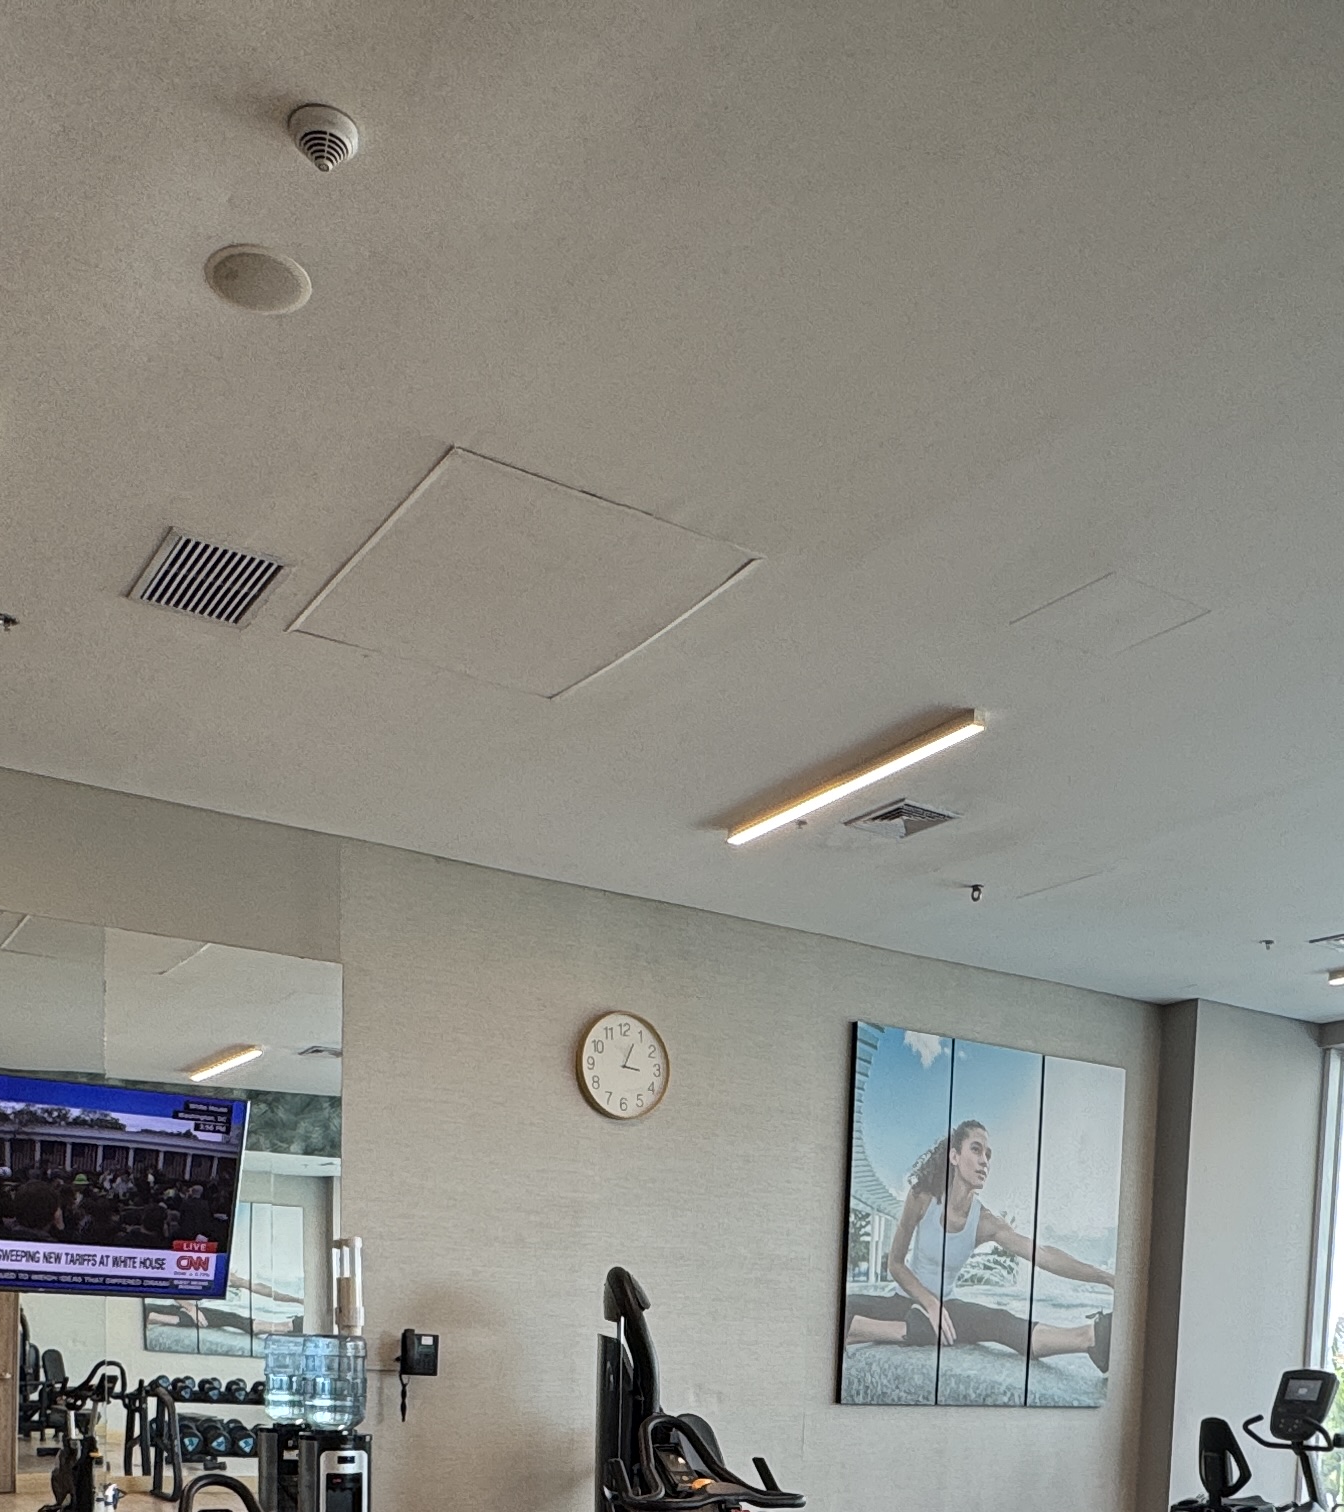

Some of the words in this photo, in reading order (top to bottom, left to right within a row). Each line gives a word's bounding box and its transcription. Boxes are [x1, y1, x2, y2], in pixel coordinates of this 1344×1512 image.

[604, 1026, 614, 1040] 11
[618, 1022, 631, 1037] 12
[591, 1039, 605, 1054] 10
[648, 1044, 657, 1059] 2
[586, 1055, 596, 1071] 9
[652, 1063, 661, 1078] 3
[591, 1075, 600, 1090] 8
[647, 1081, 655, 1095] 4
[604, 1091, 613, 1105] 7
[619, 1097, 628, 1111] 6
[635, 1093, 644, 1108] 5
[183, 1242, 207, 1252] LIVE
[42, 1251, 63, 1265] NEW
[64, 1252, 97, 1267] TARIFFS
[98, 1254, 110, 1267] AT
[112, 1255, 137, 1269] WHITE
[139, 1256, 166, 1271] HOUSE
[176, 1255, 210, 1272] CNN
